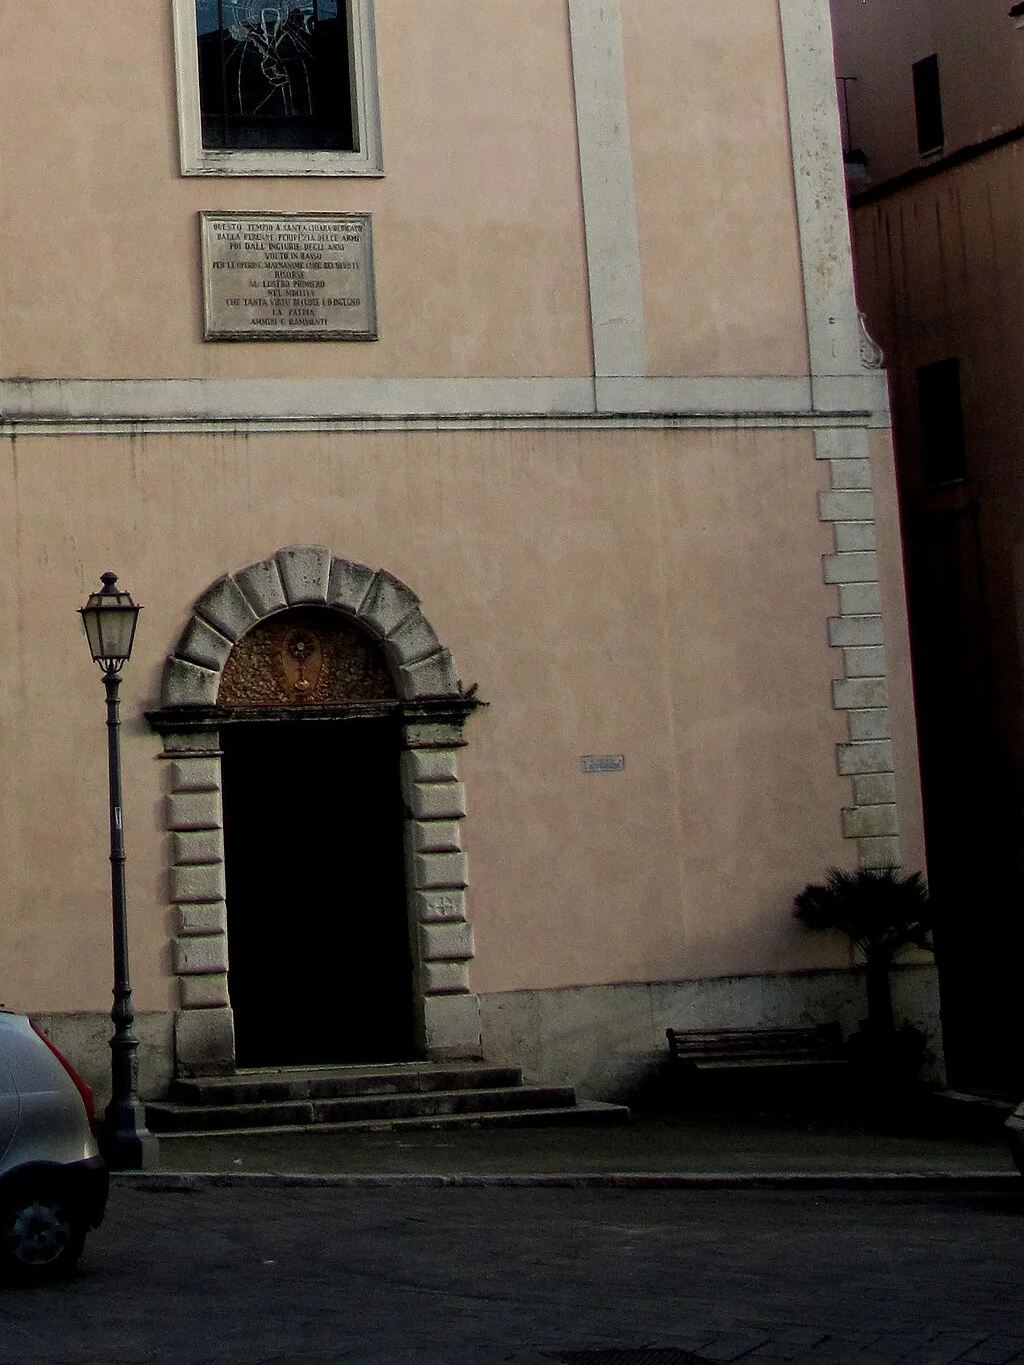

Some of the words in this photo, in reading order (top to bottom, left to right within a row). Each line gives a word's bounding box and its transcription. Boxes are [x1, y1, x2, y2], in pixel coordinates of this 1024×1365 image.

[213, 223, 242, 231] QUESTO
[248, 223, 273, 231] TEMPIO
[275, 224, 281, 232] A
[282, 224, 307, 232] SANTA
[217, 233, 241, 241] DALLA
[317, 234, 338, 243] DELLE
[229, 242, 242, 251] POI
[268, 242, 300, 252] INGIURIE
[303, 243, 324, 252] DEGLI
[327, 243, 345, 252] ANNI
[264, 252, 289, 261] VOLTO
[290, 252, 299, 260] IN
[300, 252, 322, 261] BASSO
[212, 261, 225, 270] PER
[227, 261, 235, 270] LE
[262, 280, 290, 289] LUSTRO
[225, 298, 241, 307] CHE
[243, 298, 268, 307] TANTA
[272, 308, 283, 316] LA
[288, 308, 315, 316] PATRIA
